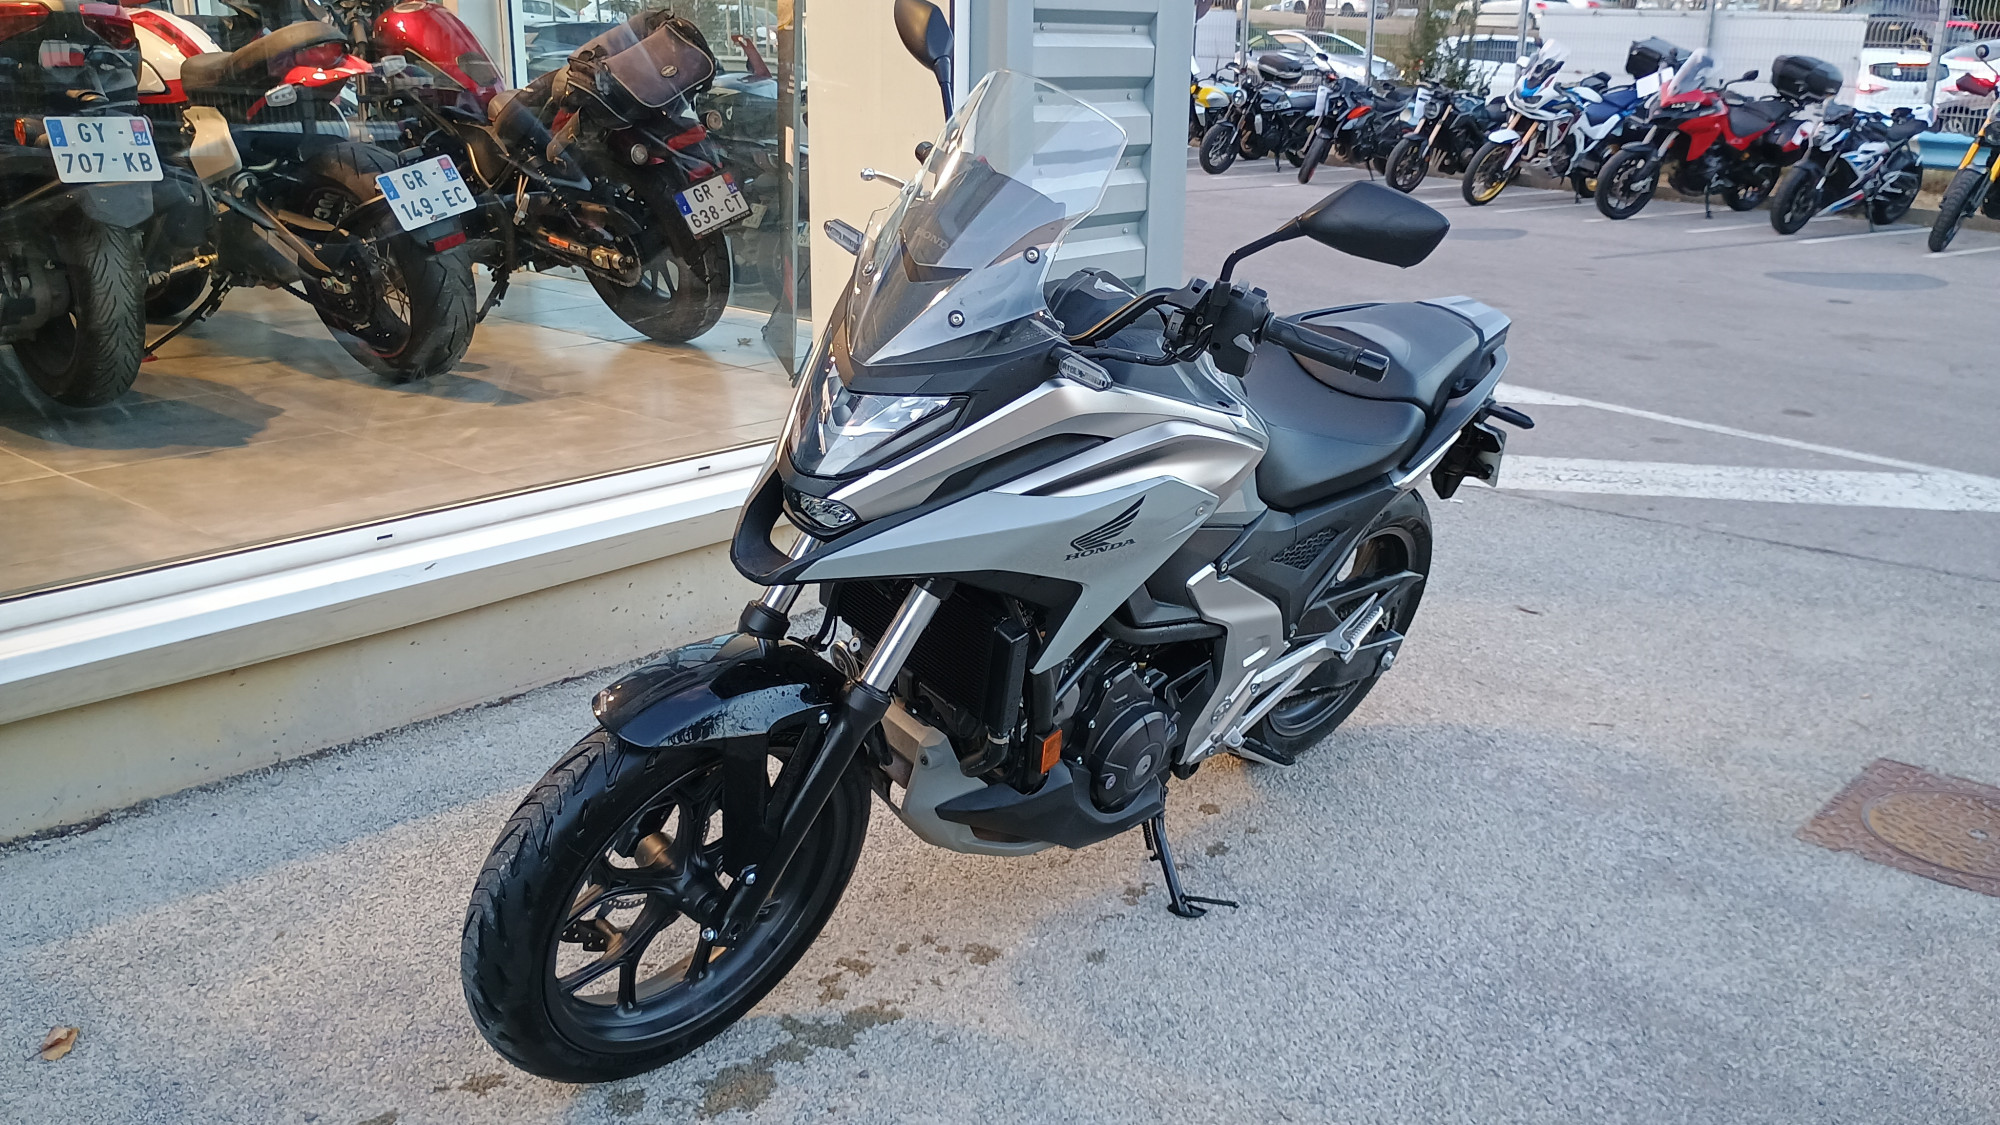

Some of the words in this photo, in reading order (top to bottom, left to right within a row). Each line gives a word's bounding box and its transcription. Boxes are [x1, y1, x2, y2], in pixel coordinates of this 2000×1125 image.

[77, 122, 105, 143] GY
[134, 132, 149, 145] 34
[401, 169, 428, 191] GR
[444, 169, 457, 181] 34
[693, 183, 714, 203] GR
[727, 182, 738, 192] 34
[914, 226, 950, 249] HOND
[1064, 538, 1136, 562] HONDA
